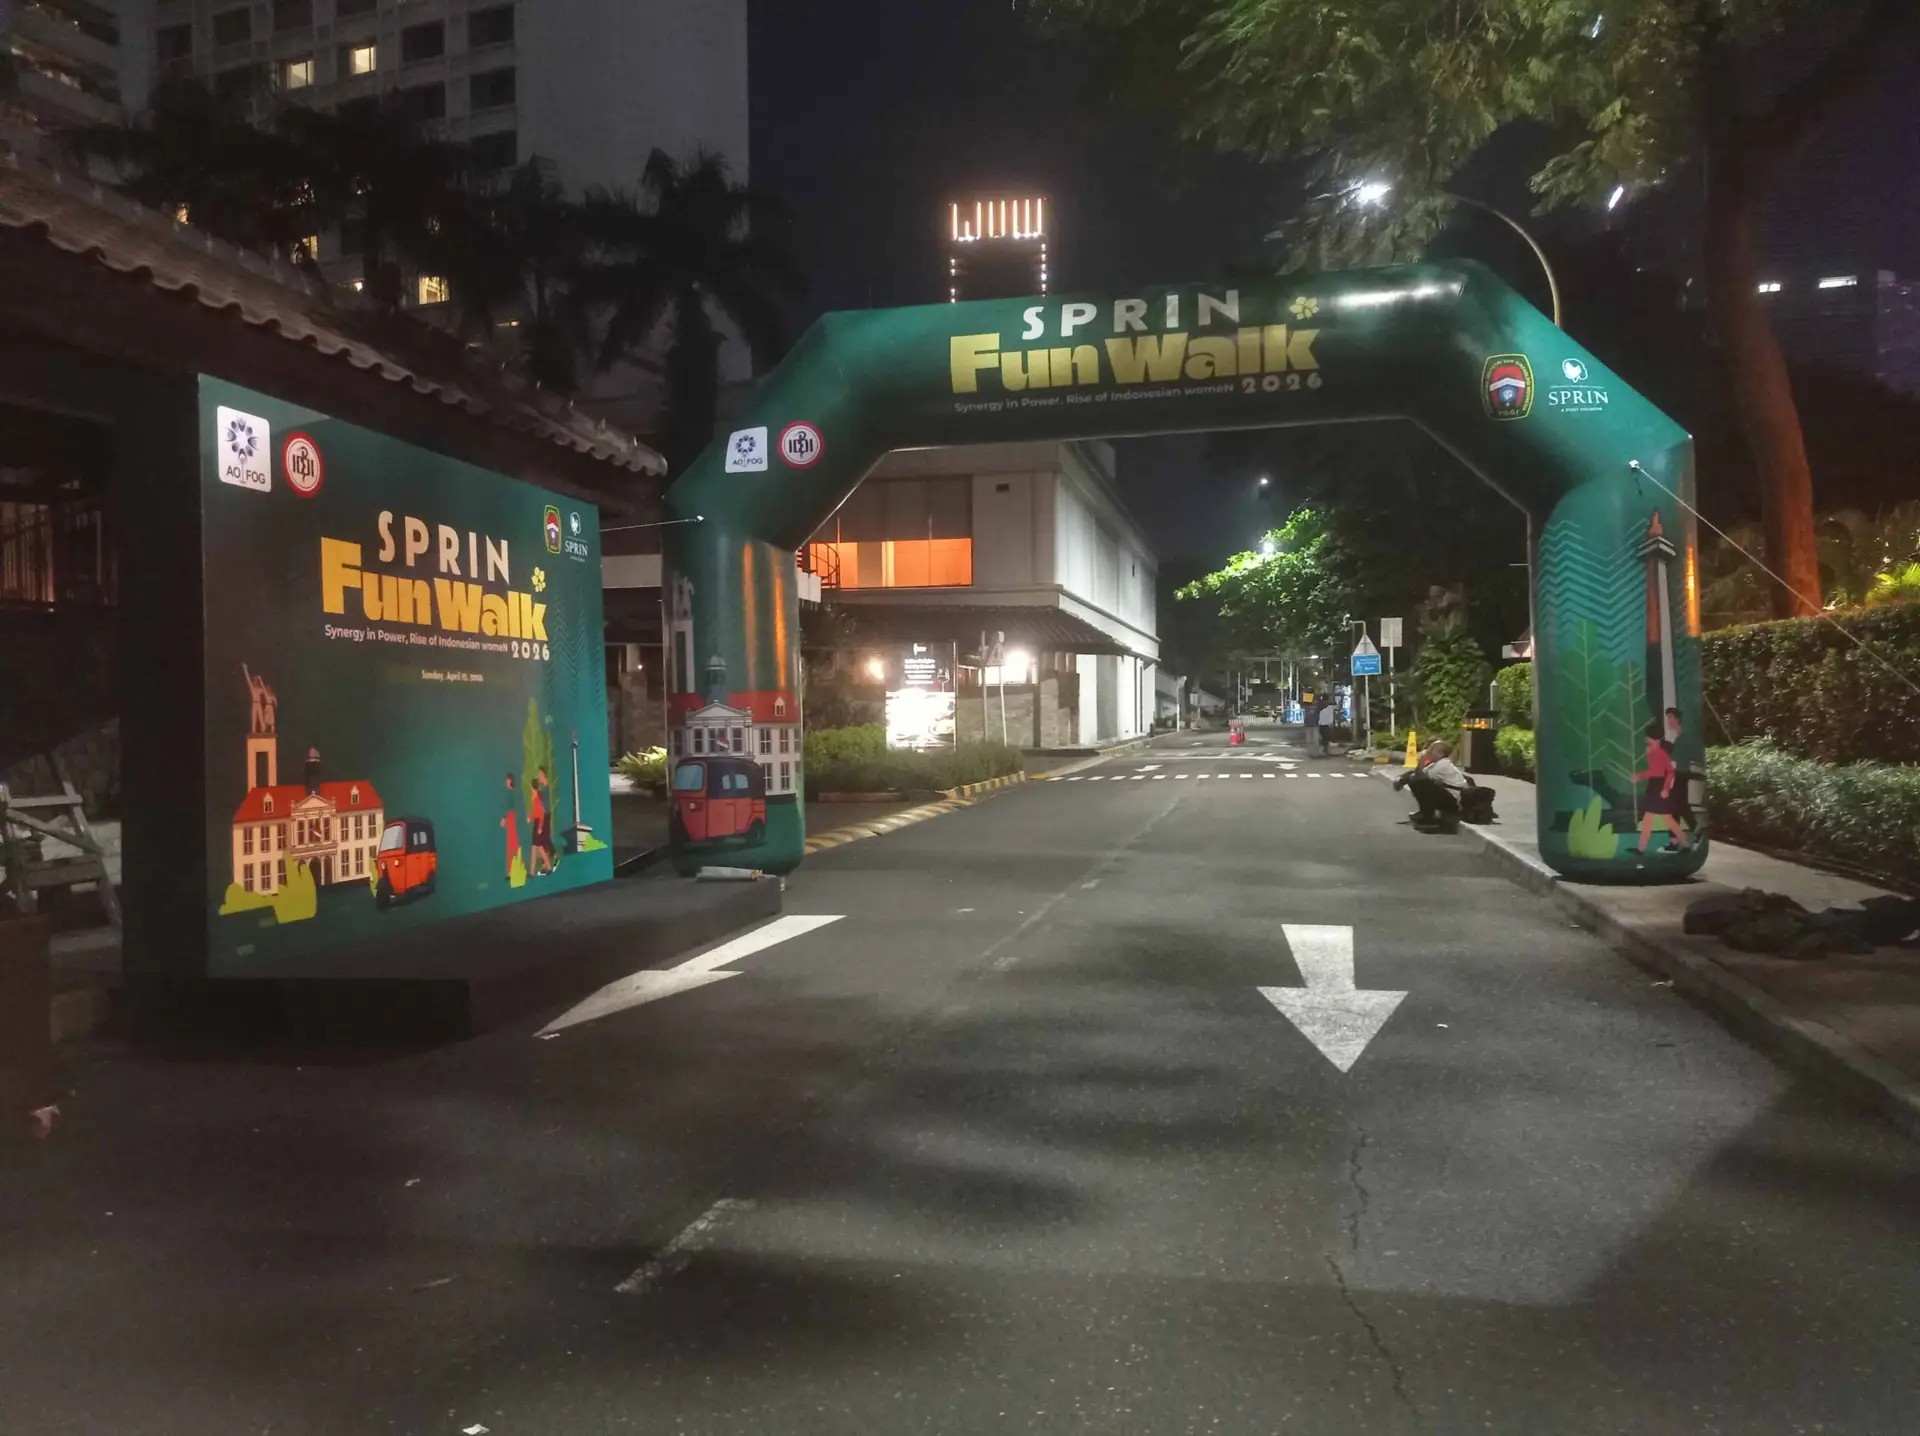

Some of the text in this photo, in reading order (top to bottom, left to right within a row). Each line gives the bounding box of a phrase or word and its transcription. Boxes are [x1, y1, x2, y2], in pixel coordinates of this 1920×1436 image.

[1021, 289, 1240, 340] SPRIN
[950, 324, 1320, 393] Fun Walk
[1242, 372, 1323, 394] 2026
[954, 399, 1003, 414] Synergy
[1006, 398, 1018, 409] in
[1066, 393, 1092, 405] Rise
[1094, 391, 1108, 403] of
[1110, 386, 1181, 401] Indonesian
[1548, 390, 1609, 405] SPRIN
[378, 510, 510, 585] SPRIN
[565, 540, 588, 556] SPRIN
[320, 536, 549, 642] Fun Walk
[324, 624, 365, 642] Synergy
[366, 628, 377, 641] in
[377, 630, 409, 645] Power,
[410, 632, 427, 645] Rise
[428, 634, 437, 646] of
[438, 635, 481, 651] Indonesian
[511, 640, 550, 661] 2026
